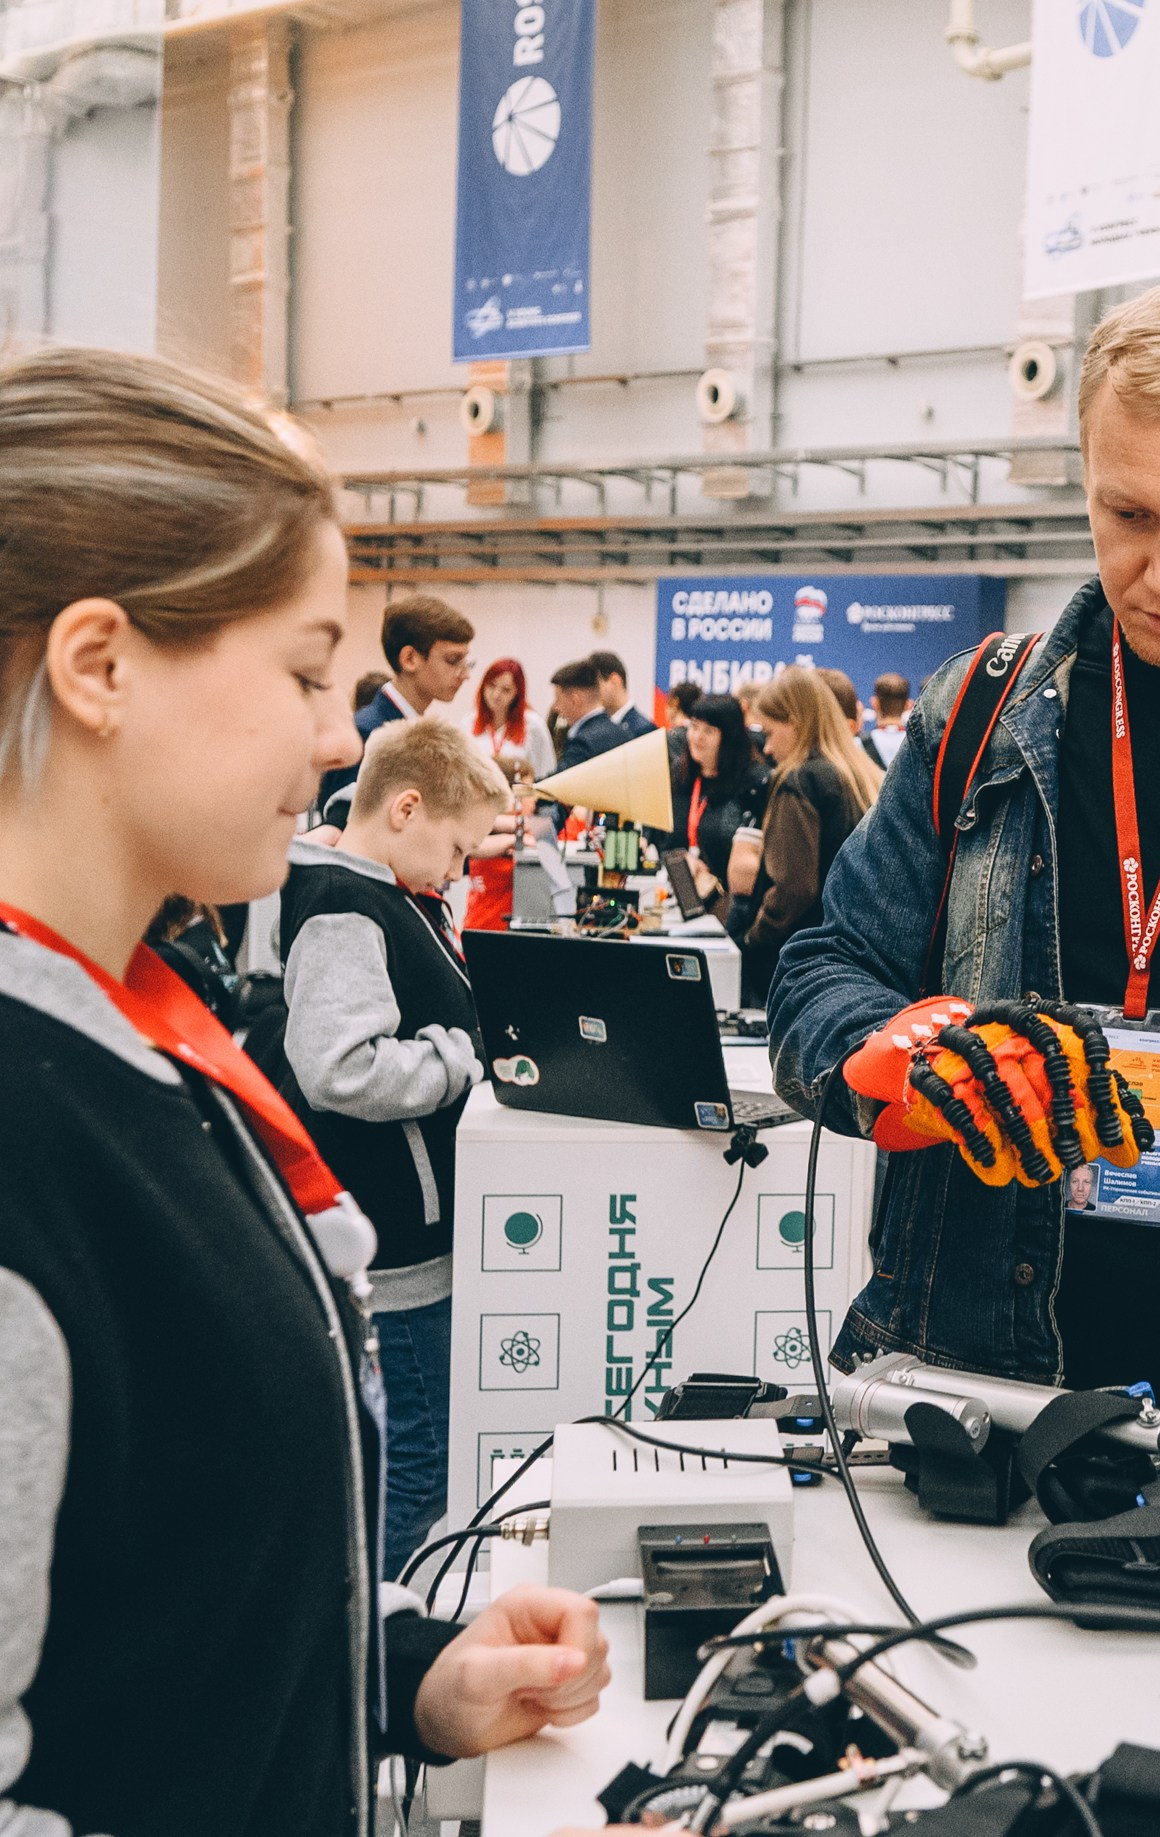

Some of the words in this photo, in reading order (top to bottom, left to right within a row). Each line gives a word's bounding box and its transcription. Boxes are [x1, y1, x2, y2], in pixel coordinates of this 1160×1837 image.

[513, 0, 545, 67] RO
[672, 590, 773, 617] СДЕЛАНО
[671, 617, 686, 641] В
[688, 617, 773, 642] РОССИИ
[986, 633, 1030, 677] Can
[669, 656, 815, 695] ВЫБИР
[1113, 656, 1126, 739] ROSCONGRESS
[1126, 873, 1142, 956] РОСКОНГР
[1103, 1178, 1137, 1187] Шалимов
[1104, 1170, 1137, 1179] Вячеслав
[1101, 1205, 1149, 1216] ПЕРСОНАЛ
